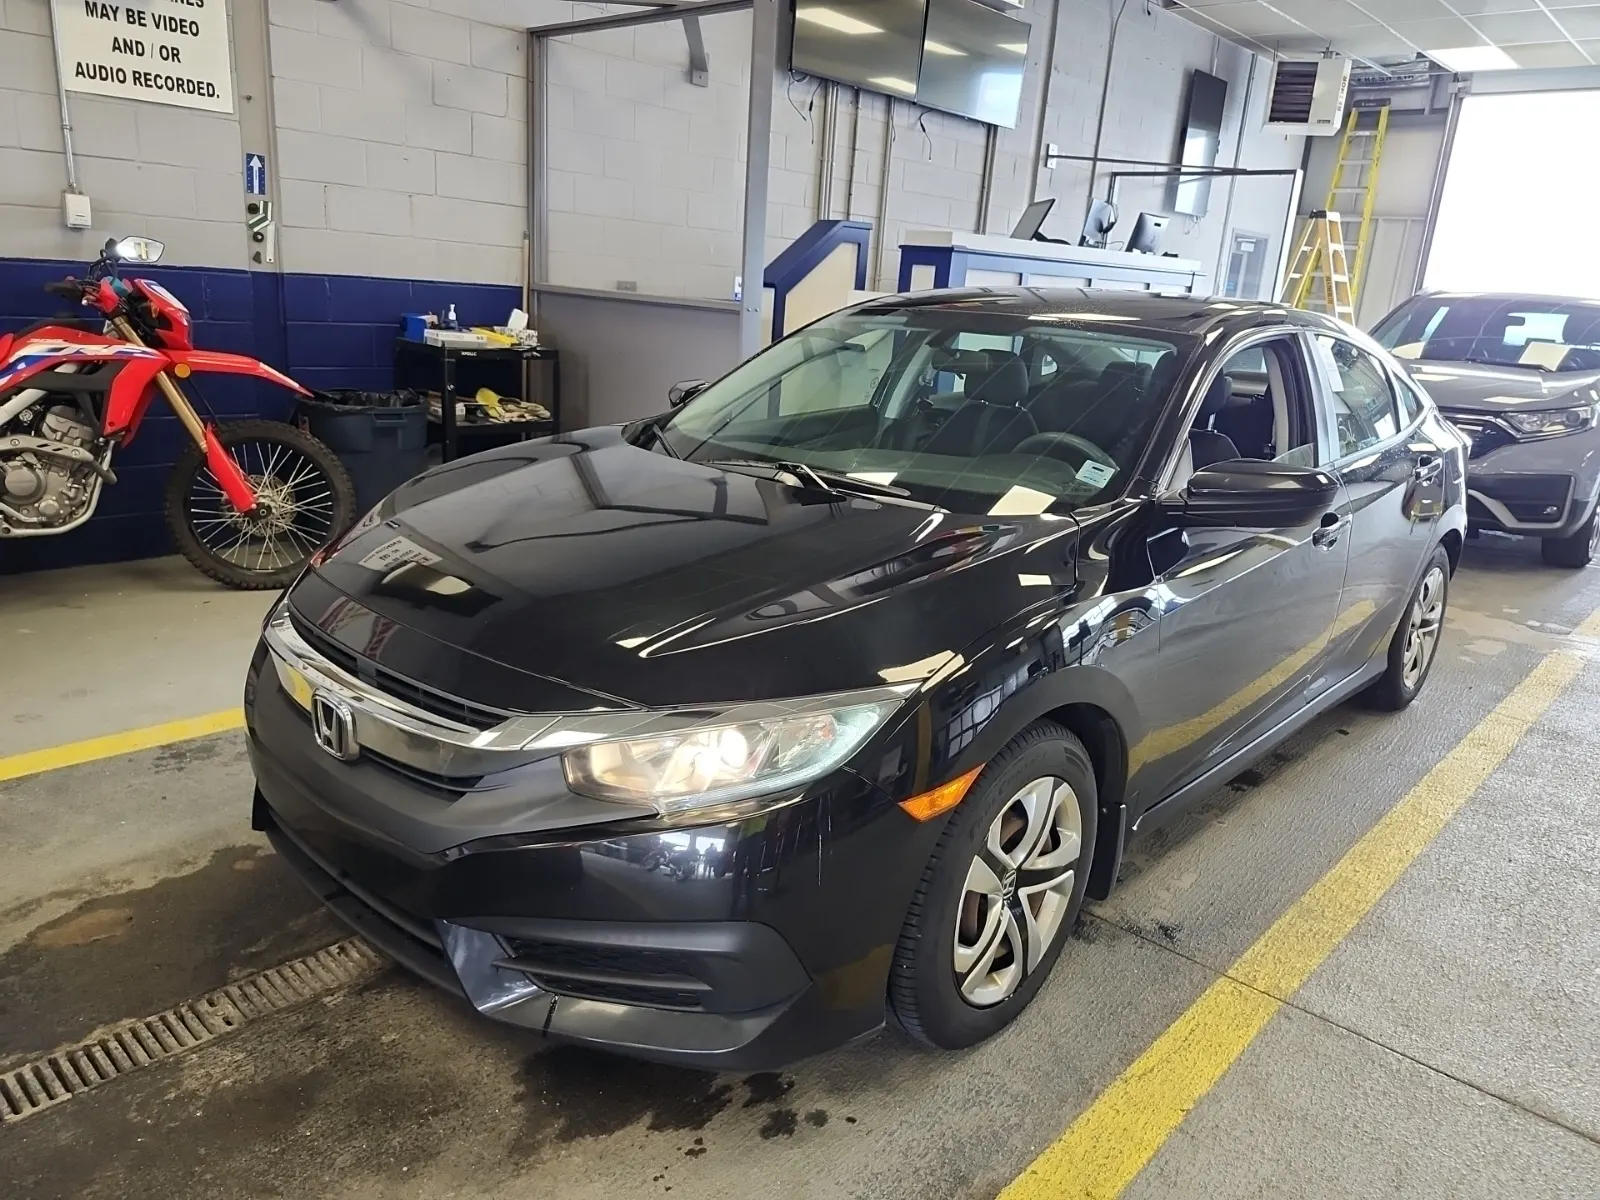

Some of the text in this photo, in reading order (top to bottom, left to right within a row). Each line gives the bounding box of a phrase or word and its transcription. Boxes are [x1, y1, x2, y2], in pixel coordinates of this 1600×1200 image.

[84, 0, 200, 37] MAY BE VIDEO
[112, 36, 182, 63] AND / OR
[75, 62, 220, 99] AUDIO RECORDED.
